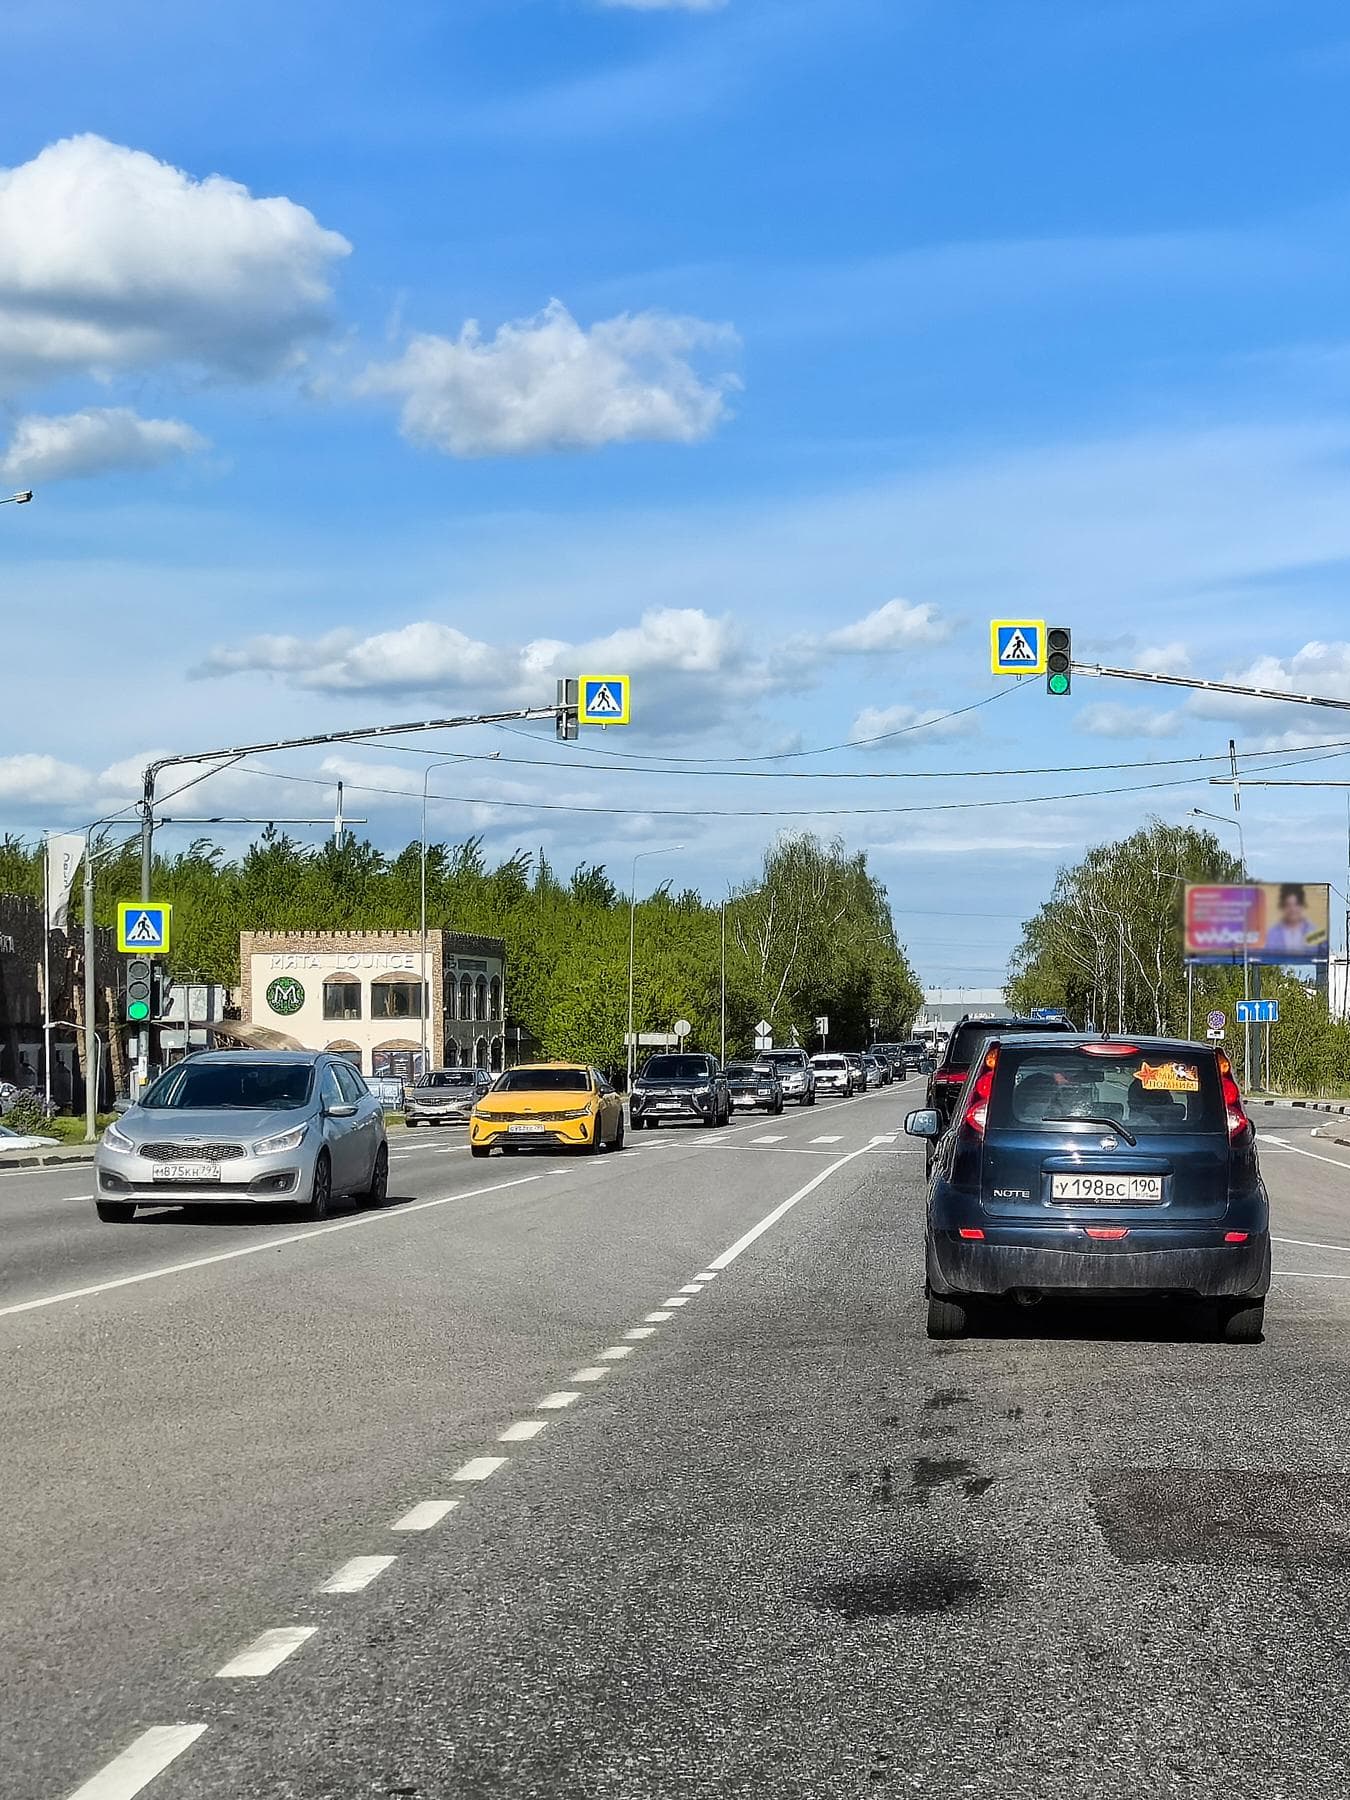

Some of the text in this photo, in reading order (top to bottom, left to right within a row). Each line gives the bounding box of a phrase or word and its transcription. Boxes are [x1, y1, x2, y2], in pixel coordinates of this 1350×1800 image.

[270, 954, 322, 970] МЯТА
[993, 1188, 1031, 1198] NOTE
[1131, 1179, 1156, 1193] 190
